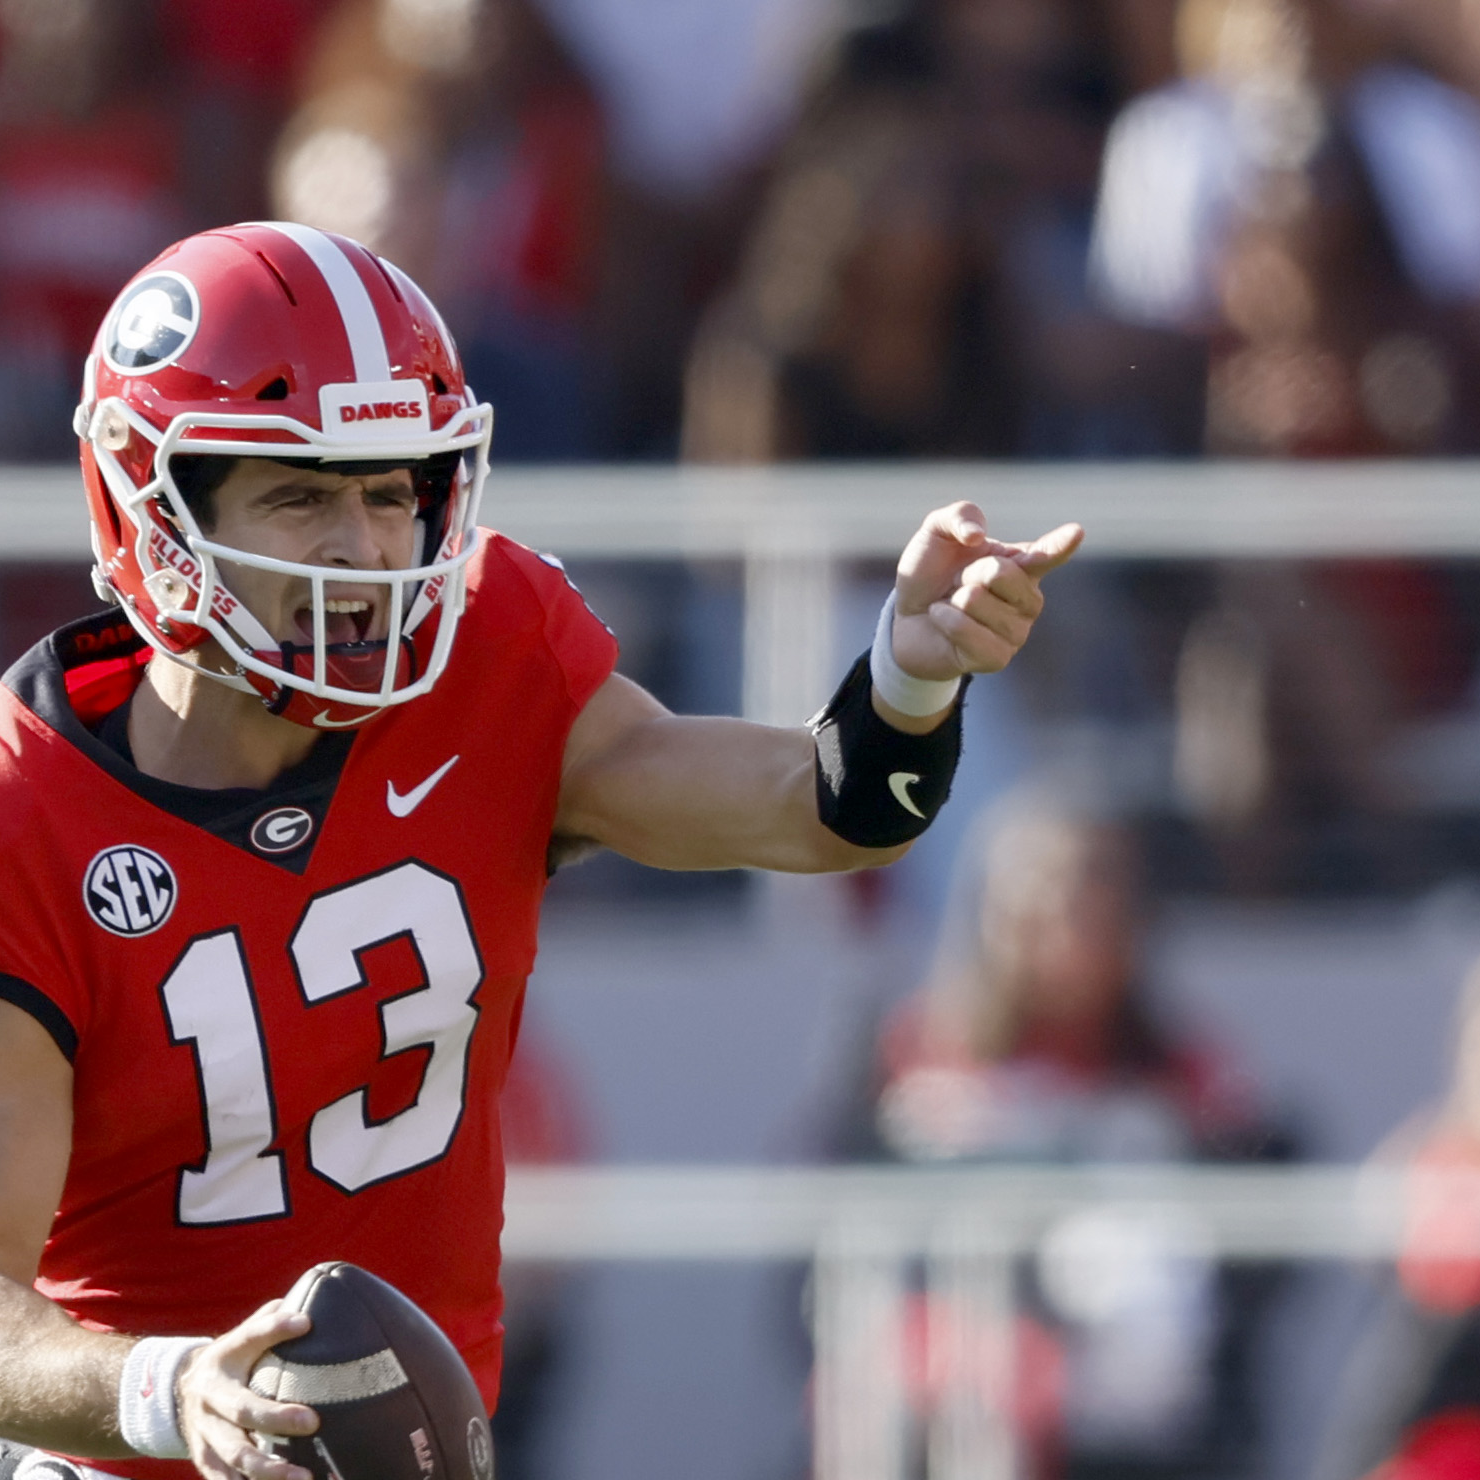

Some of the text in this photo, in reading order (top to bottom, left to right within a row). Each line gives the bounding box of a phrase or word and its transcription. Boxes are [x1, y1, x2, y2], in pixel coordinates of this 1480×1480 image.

[339, 401, 422, 423] DAWGS
[90, 850, 170, 931] SEC
[158, 856, 485, 1228] 13
